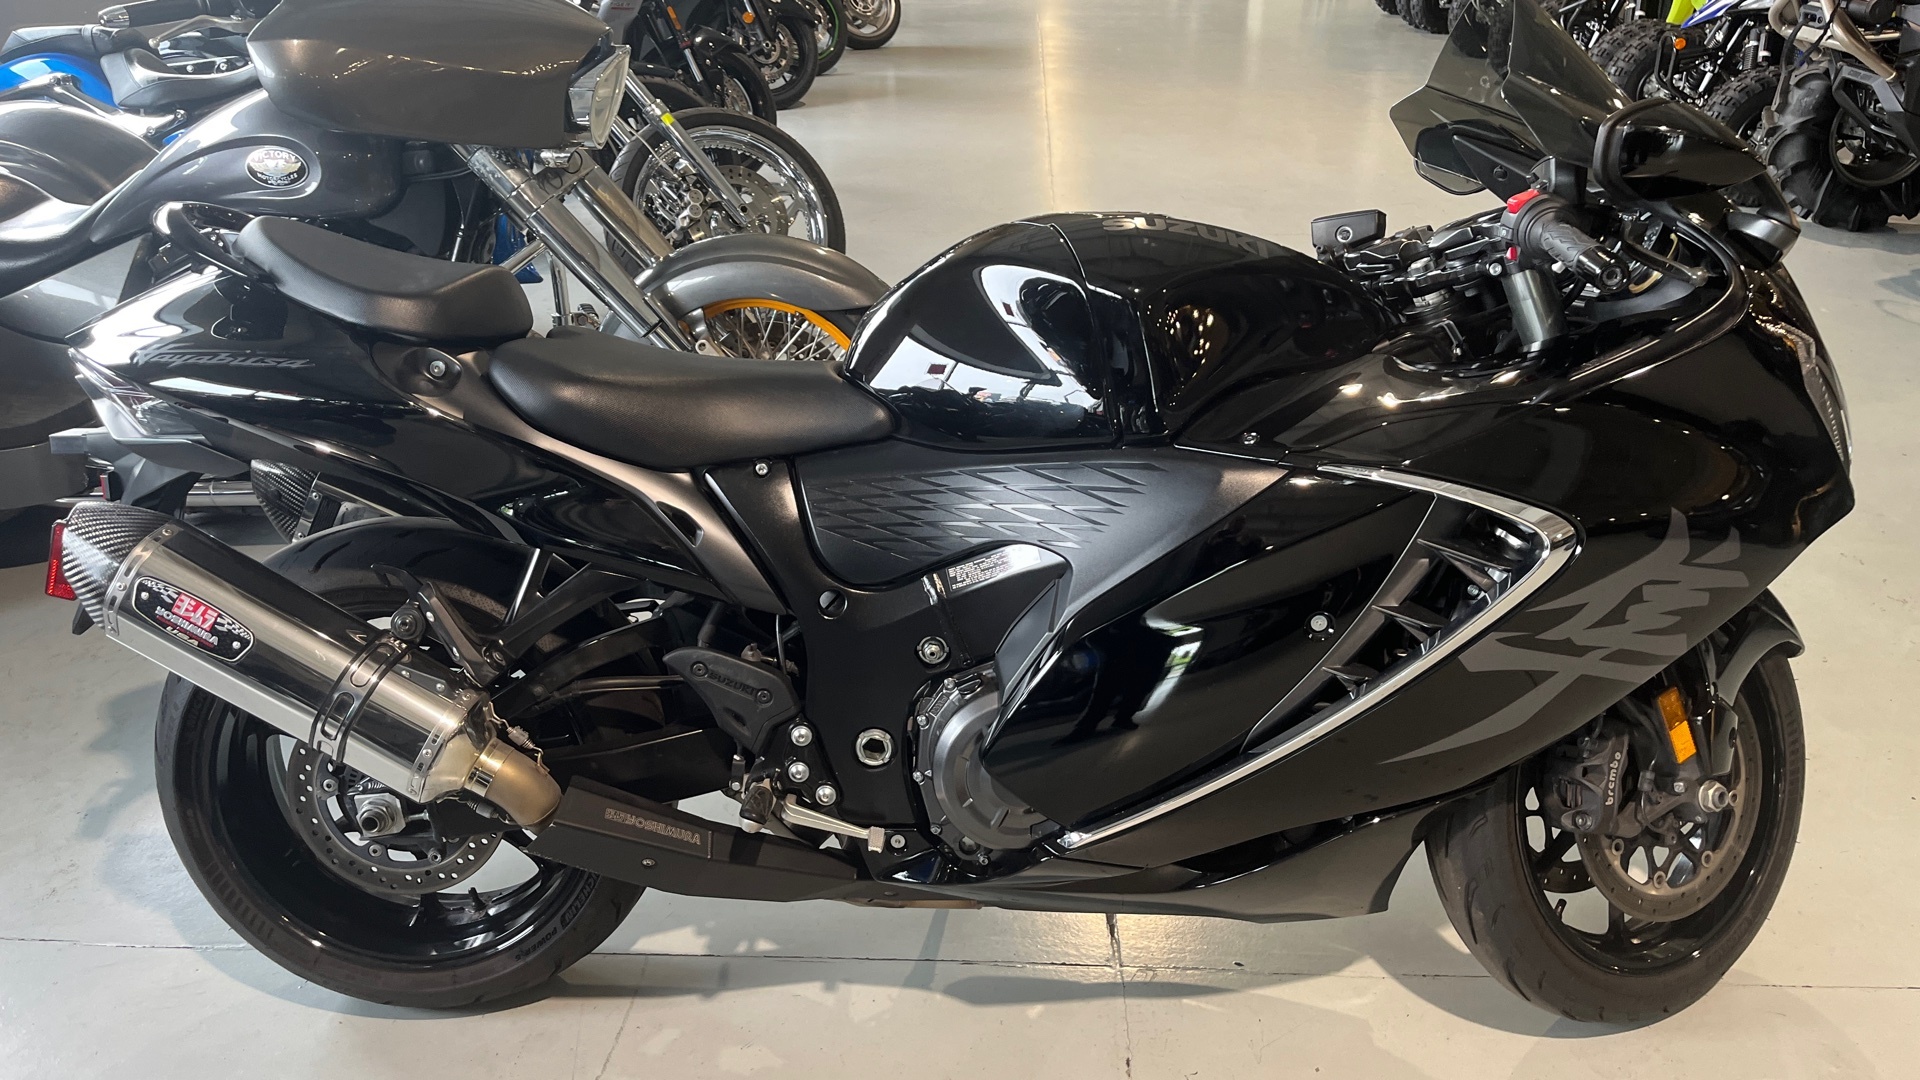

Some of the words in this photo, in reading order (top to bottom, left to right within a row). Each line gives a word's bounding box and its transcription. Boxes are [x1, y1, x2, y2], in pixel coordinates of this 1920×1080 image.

[1102, 217, 1269, 259] SUZUKI
[155, 606, 219, 646] YOSHIMURA
[166, 626, 199, 647] USA
[708, 671, 757, 696] SUZUKI
